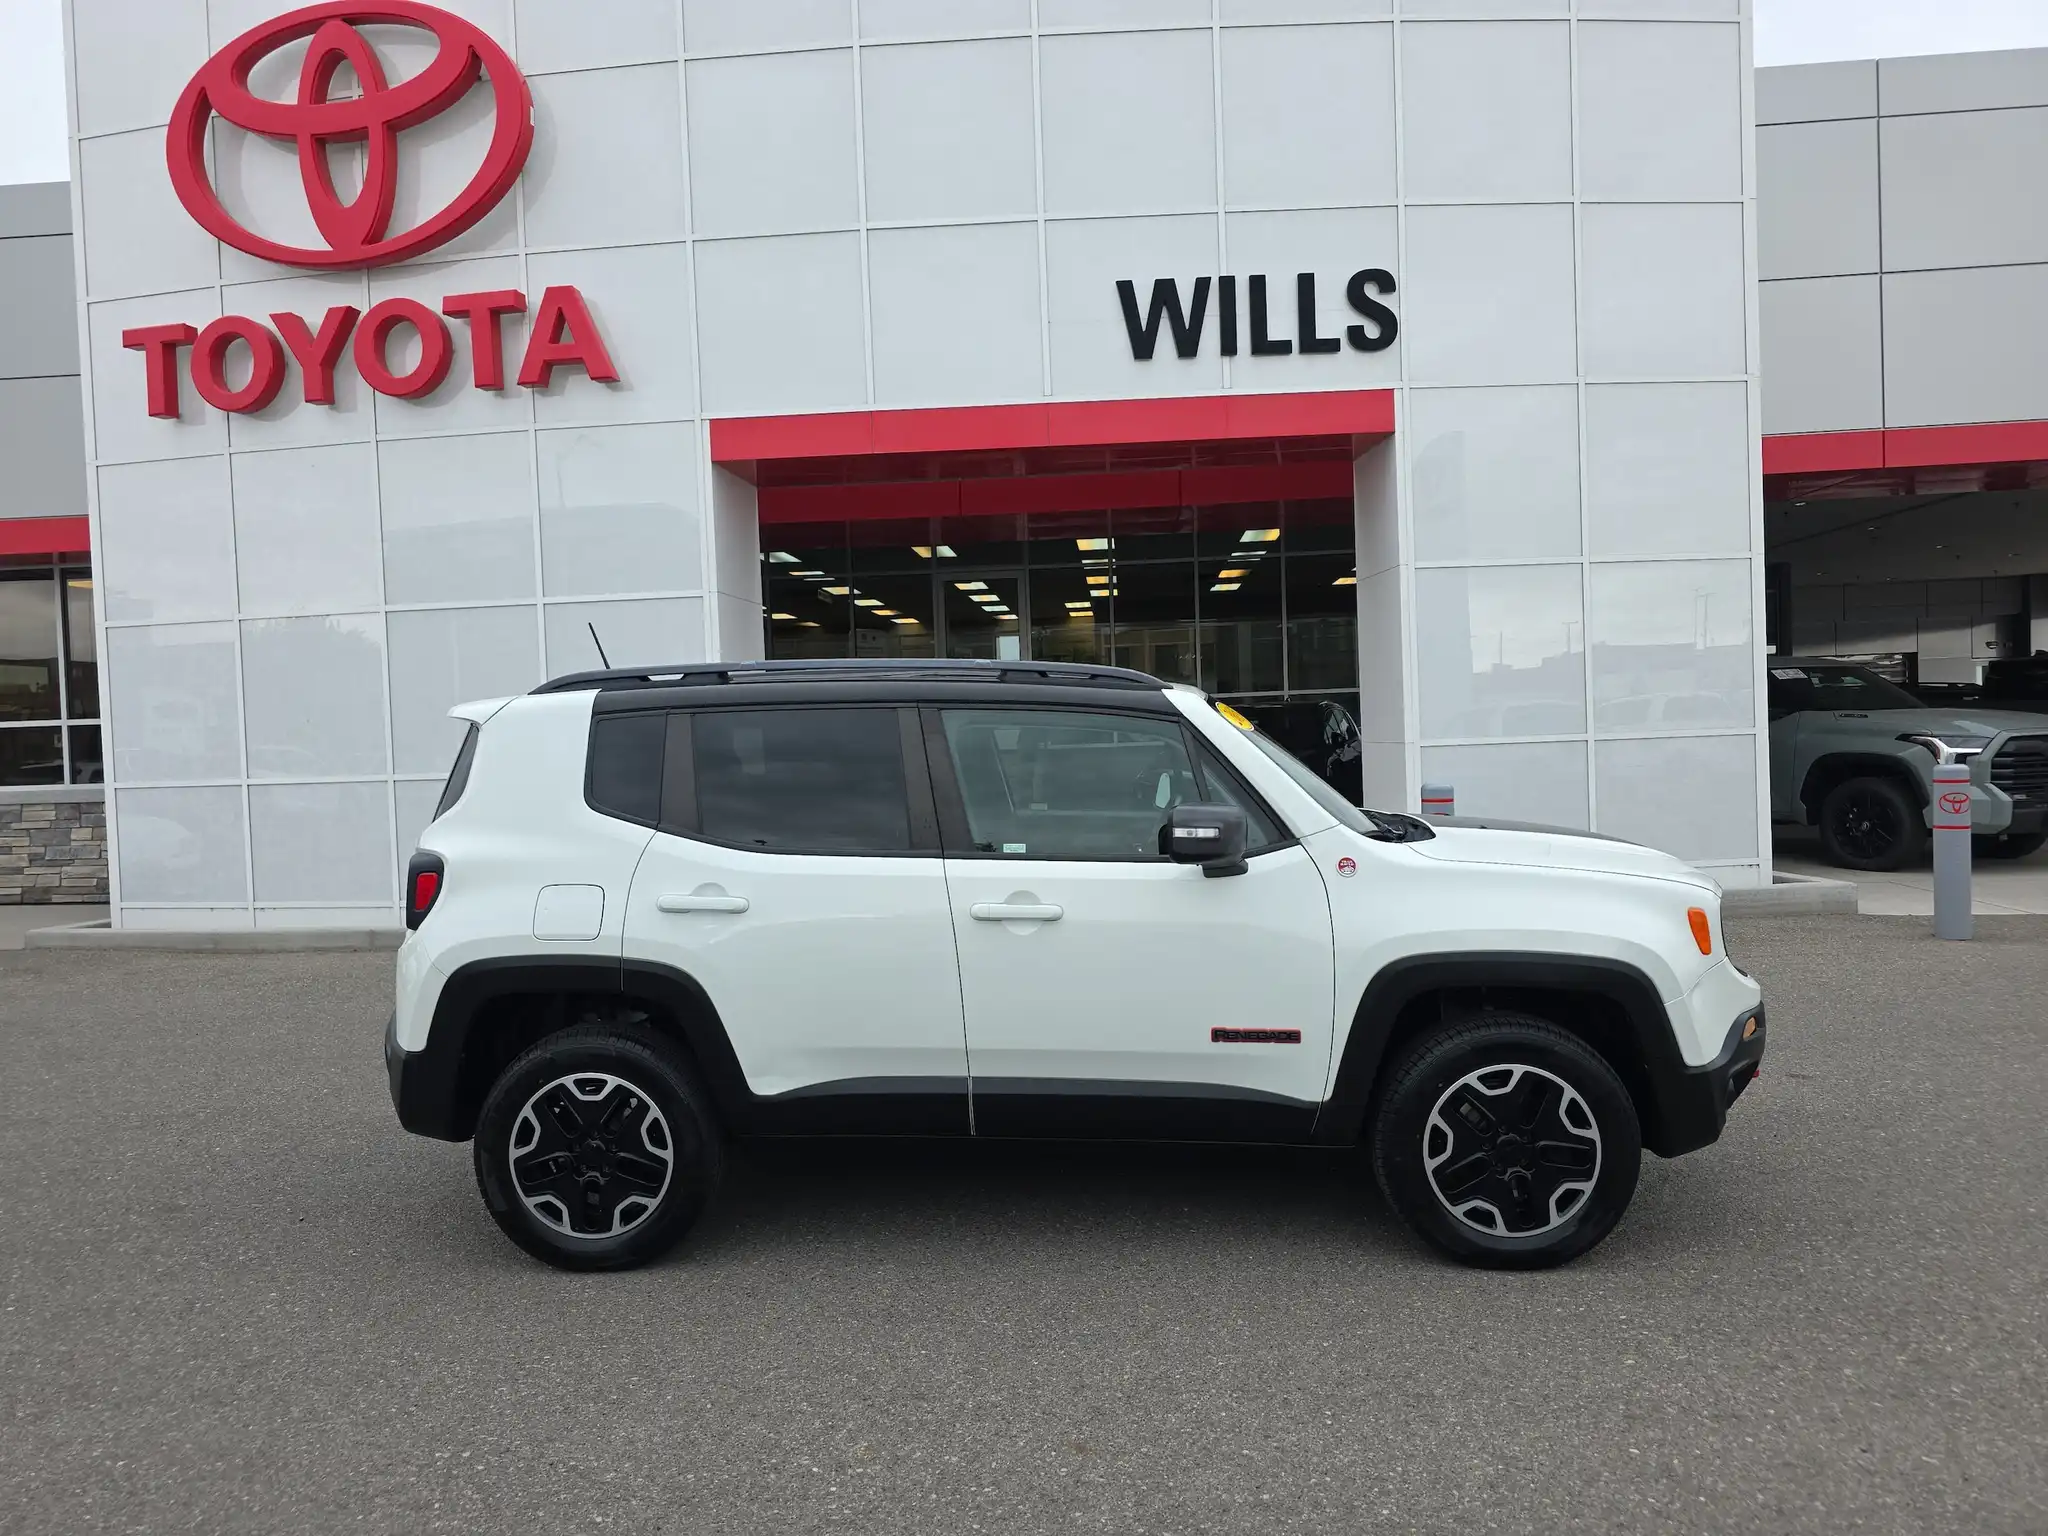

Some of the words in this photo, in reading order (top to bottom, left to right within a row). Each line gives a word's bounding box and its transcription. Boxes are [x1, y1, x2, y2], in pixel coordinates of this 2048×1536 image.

[122, 285, 620, 419] TOYOTA
[1115, 268, 1399, 360] WILLS
[1212, 1028, 1300, 1043] RENEGADE
